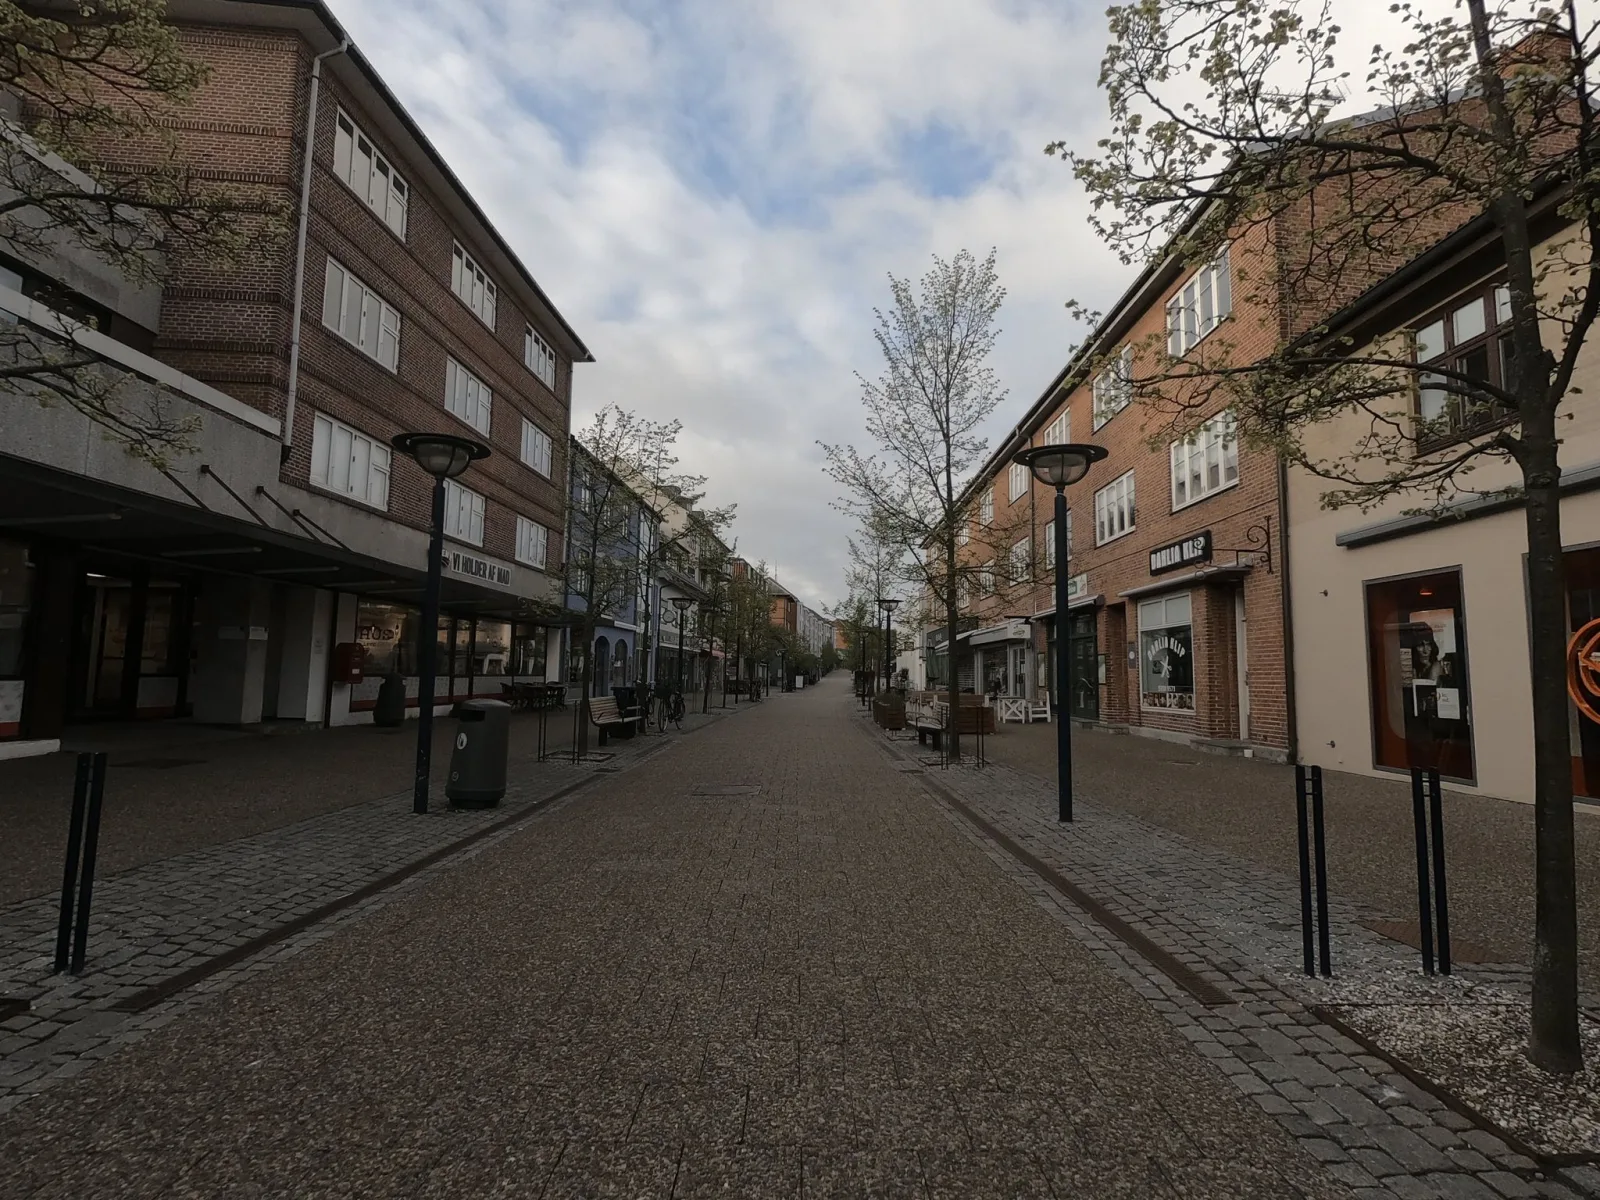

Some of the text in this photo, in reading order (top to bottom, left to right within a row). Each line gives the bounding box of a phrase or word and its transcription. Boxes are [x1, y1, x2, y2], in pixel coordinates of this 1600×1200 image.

[452, 552, 461, 572] VI
[461, 555, 488, 580] HOLDER
[488, 564, 497, 582] AF
[497, 567, 511, 586] MAD
[1150, 536, 1206, 571] DAHLIA KLIP
[1147, 636, 1186, 662] DAHLIA KLIP
